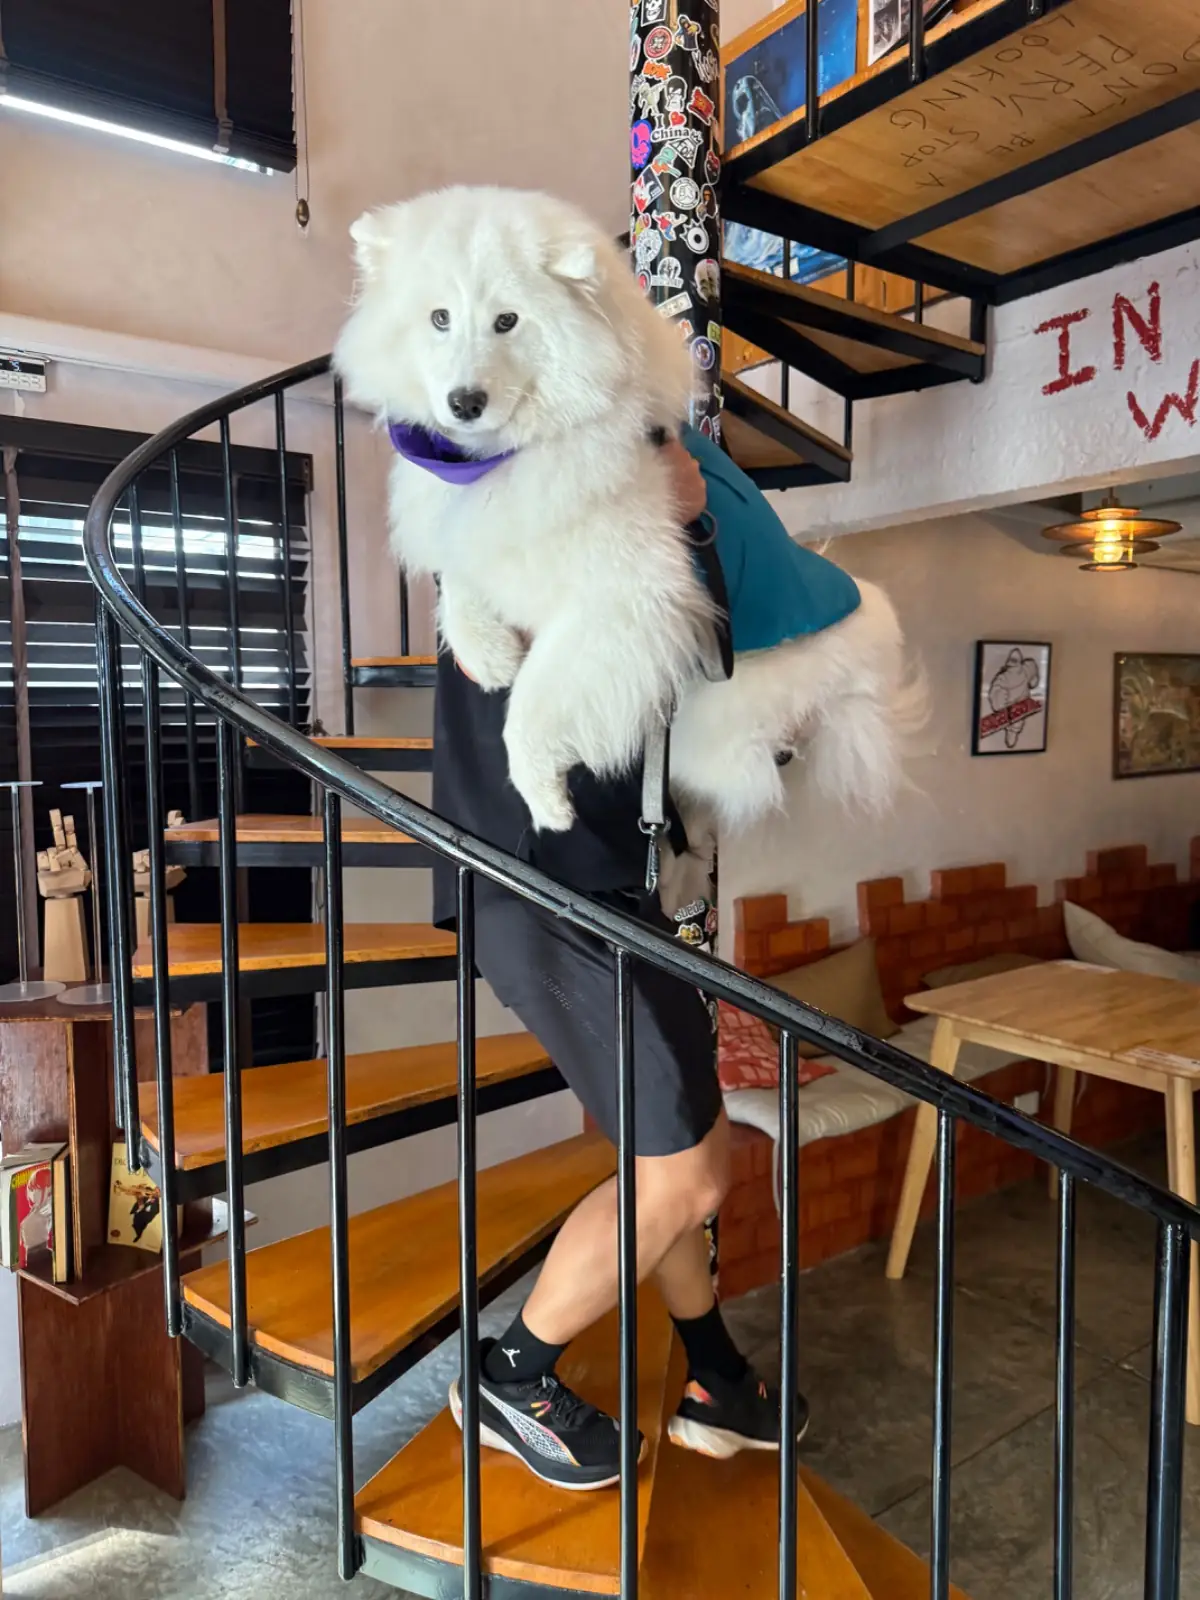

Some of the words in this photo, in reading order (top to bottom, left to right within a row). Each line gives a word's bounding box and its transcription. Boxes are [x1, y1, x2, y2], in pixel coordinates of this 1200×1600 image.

[890, 13, 1075, 130] LOOKING
[651, 127, 690, 140] China
[900, 127, 980, 168] STOP
[916, 172, 945, 189] A
[1034, 281, 1162, 396] IN
